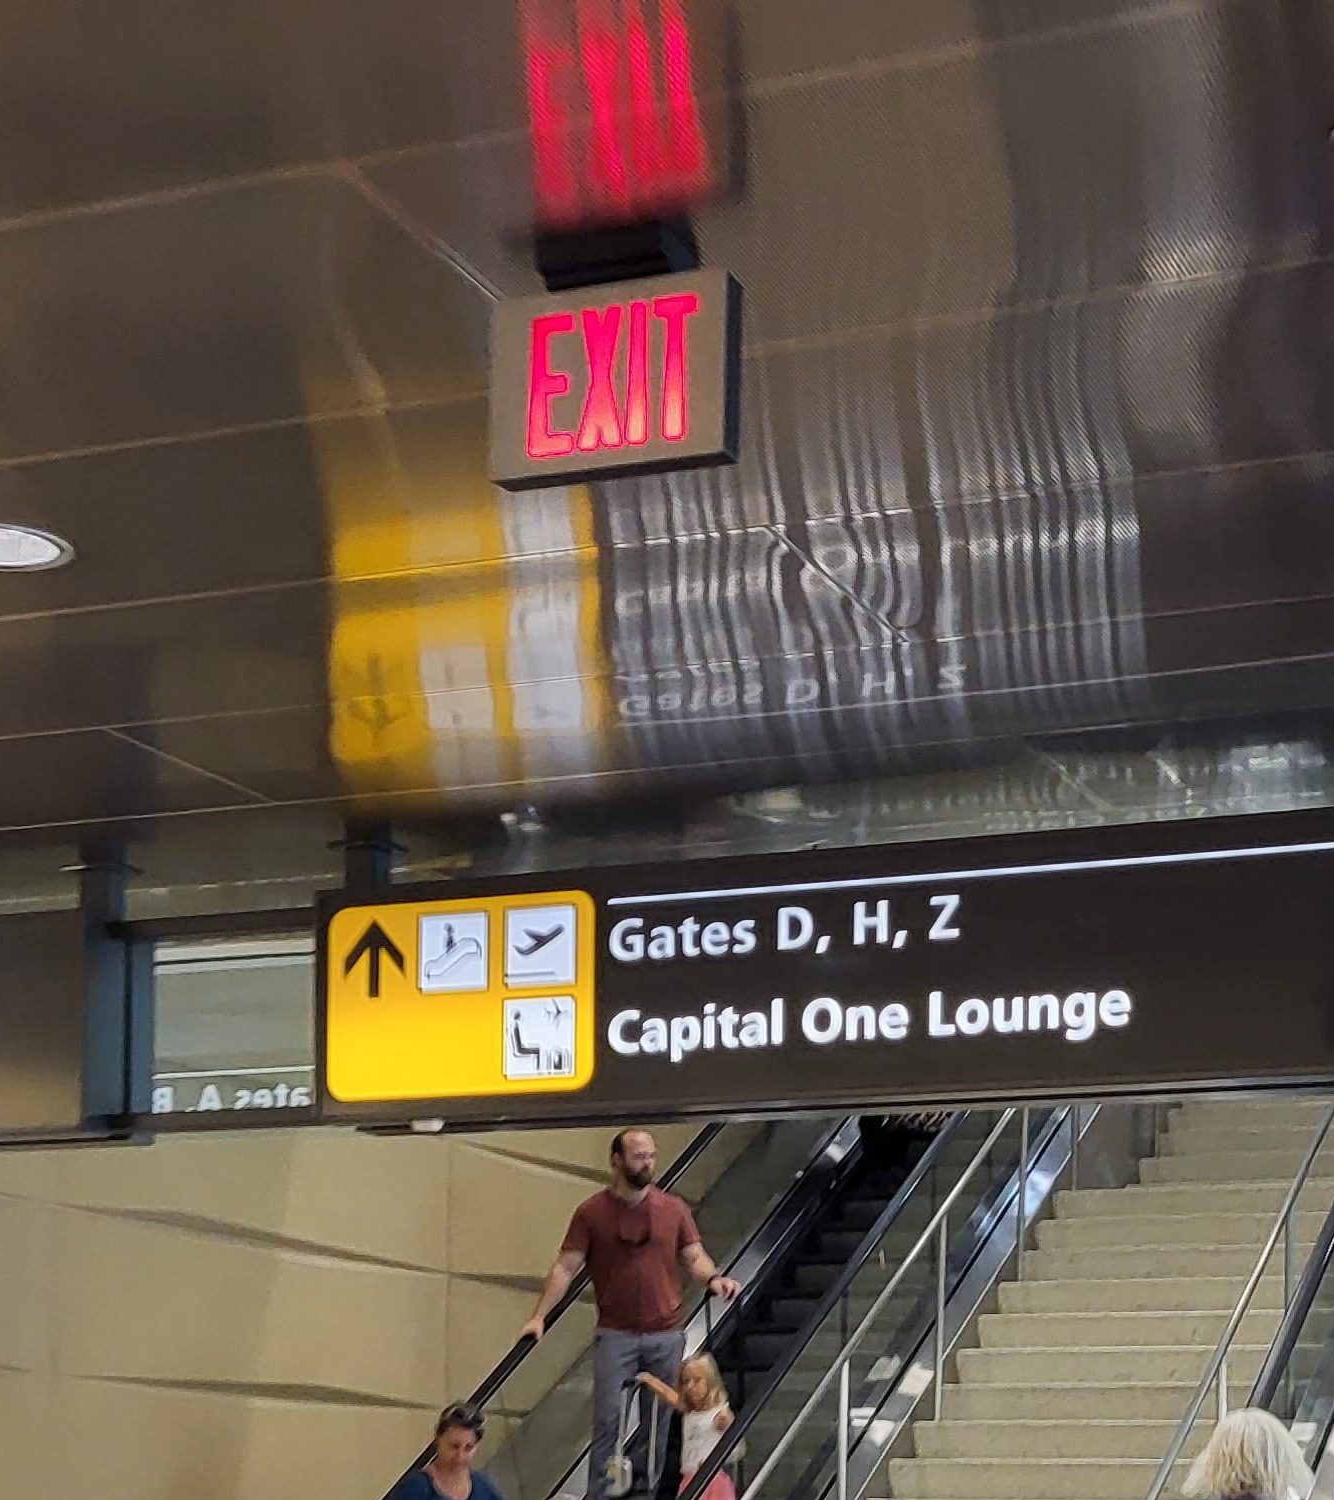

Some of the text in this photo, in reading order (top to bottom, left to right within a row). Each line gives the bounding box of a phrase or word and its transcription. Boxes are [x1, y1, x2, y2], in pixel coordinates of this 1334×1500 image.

[526, 291, 700, 459] EXIT
[607, 894, 962, 962] Gates D, H, Z
[607, 988, 1132, 1064] Capital One Lounge
